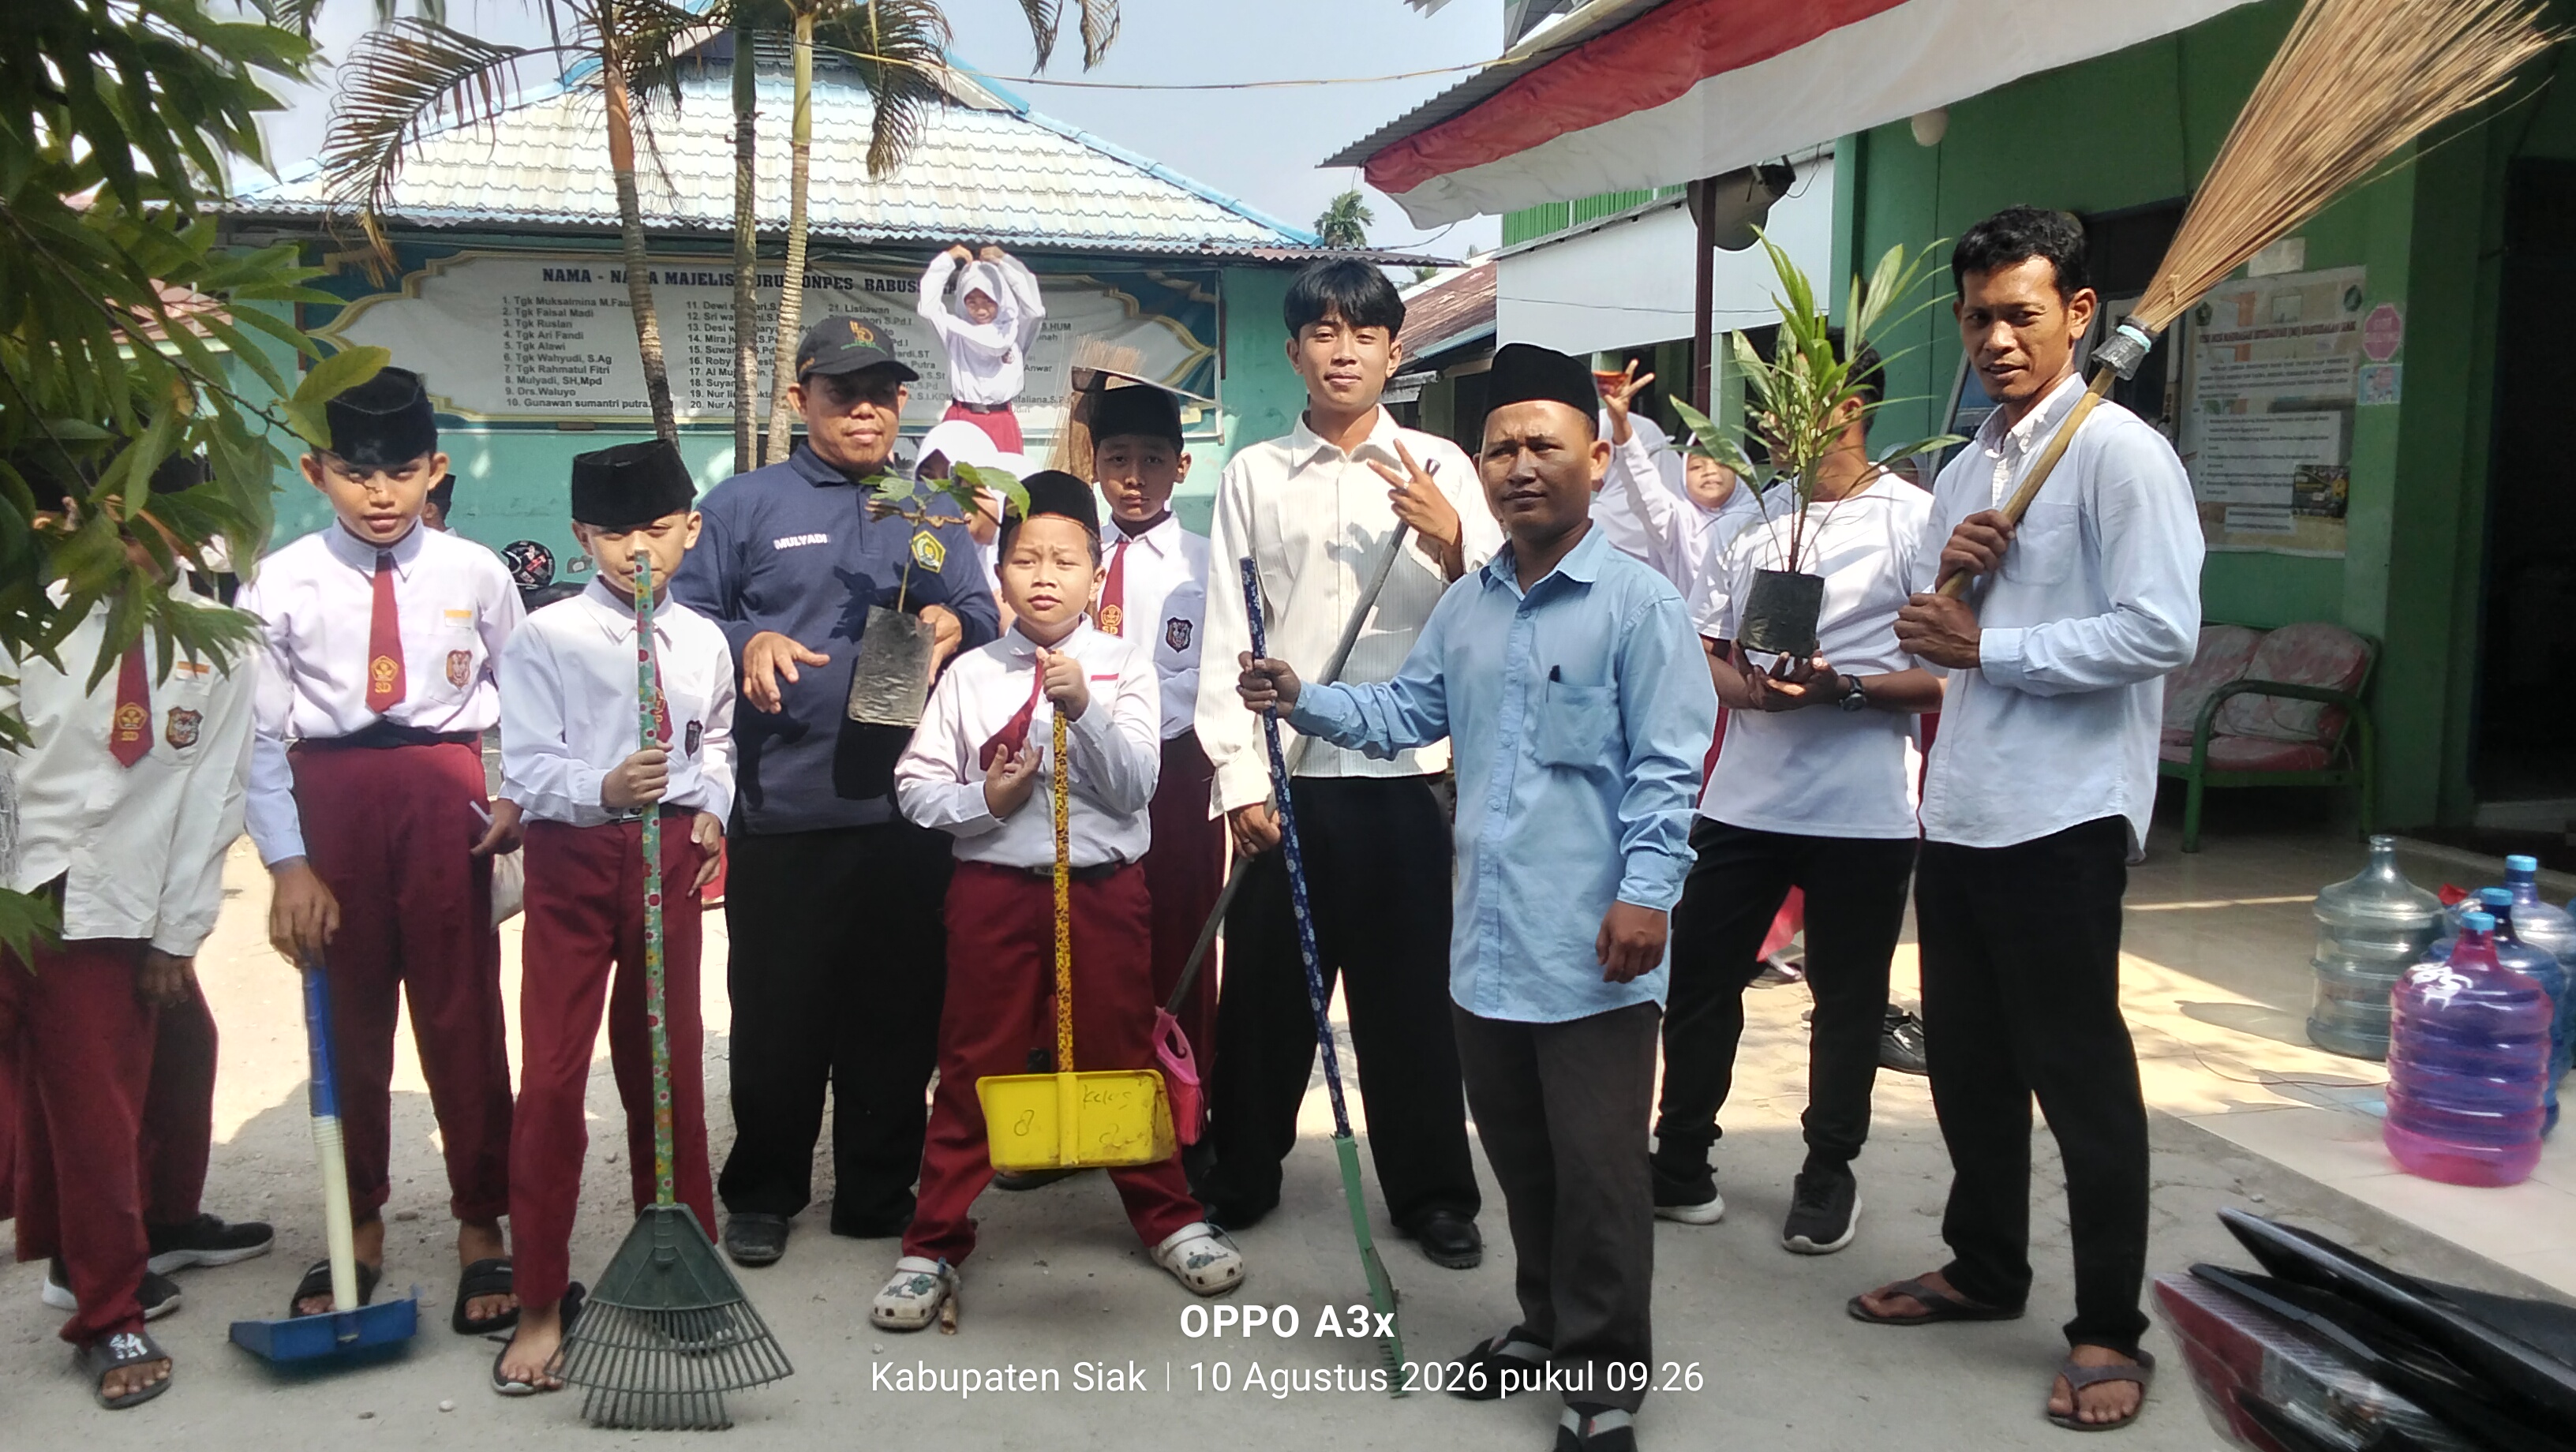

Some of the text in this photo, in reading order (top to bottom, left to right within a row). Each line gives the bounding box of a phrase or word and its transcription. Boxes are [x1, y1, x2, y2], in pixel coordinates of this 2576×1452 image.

[542, 268, 592, 283] NAMA
[610, 270, 659, 285] NAA
[665, 271, 735, 286] MAJELIS
[803, 275, 853, 290] ONPES
[503, 296, 510, 305] 1.
[514, 296, 533, 306] Tgk
[703, 301, 727, 310] Dewi
[514, 309, 533, 318] Tgk
[703, 312, 717, 321] Sri
[515, 320, 534, 329] Tgk
[537, 320, 572, 328] Ruslan
[704, 324, 726, 332] Desi
[516, 331, 534, 340] Tgk
[516, 342, 535, 352] Tgk
[537, 342, 566, 350] Alawi
[516, 354, 534, 364] Tgk
[587, 355, 612, 365] S.Ag
[706, 357, 731, 367] Roby
[516, 365, 535, 375] Tgk
[538, 365, 586, 374] Rahmatul
[590, 365, 610, 374] Fitri
[911, 361, 936, 369] Putra
[518, 387, 576, 397] Drs.Waluyo
[524, 399, 572, 407] Gunawan
[575, 399, 619, 408] sumantri
[773, 533, 828, 550] MULYADI
[1103, 625, 1118, 635] SD
[375, 681, 392, 693] SD
[121, 731, 139, 741] SD
